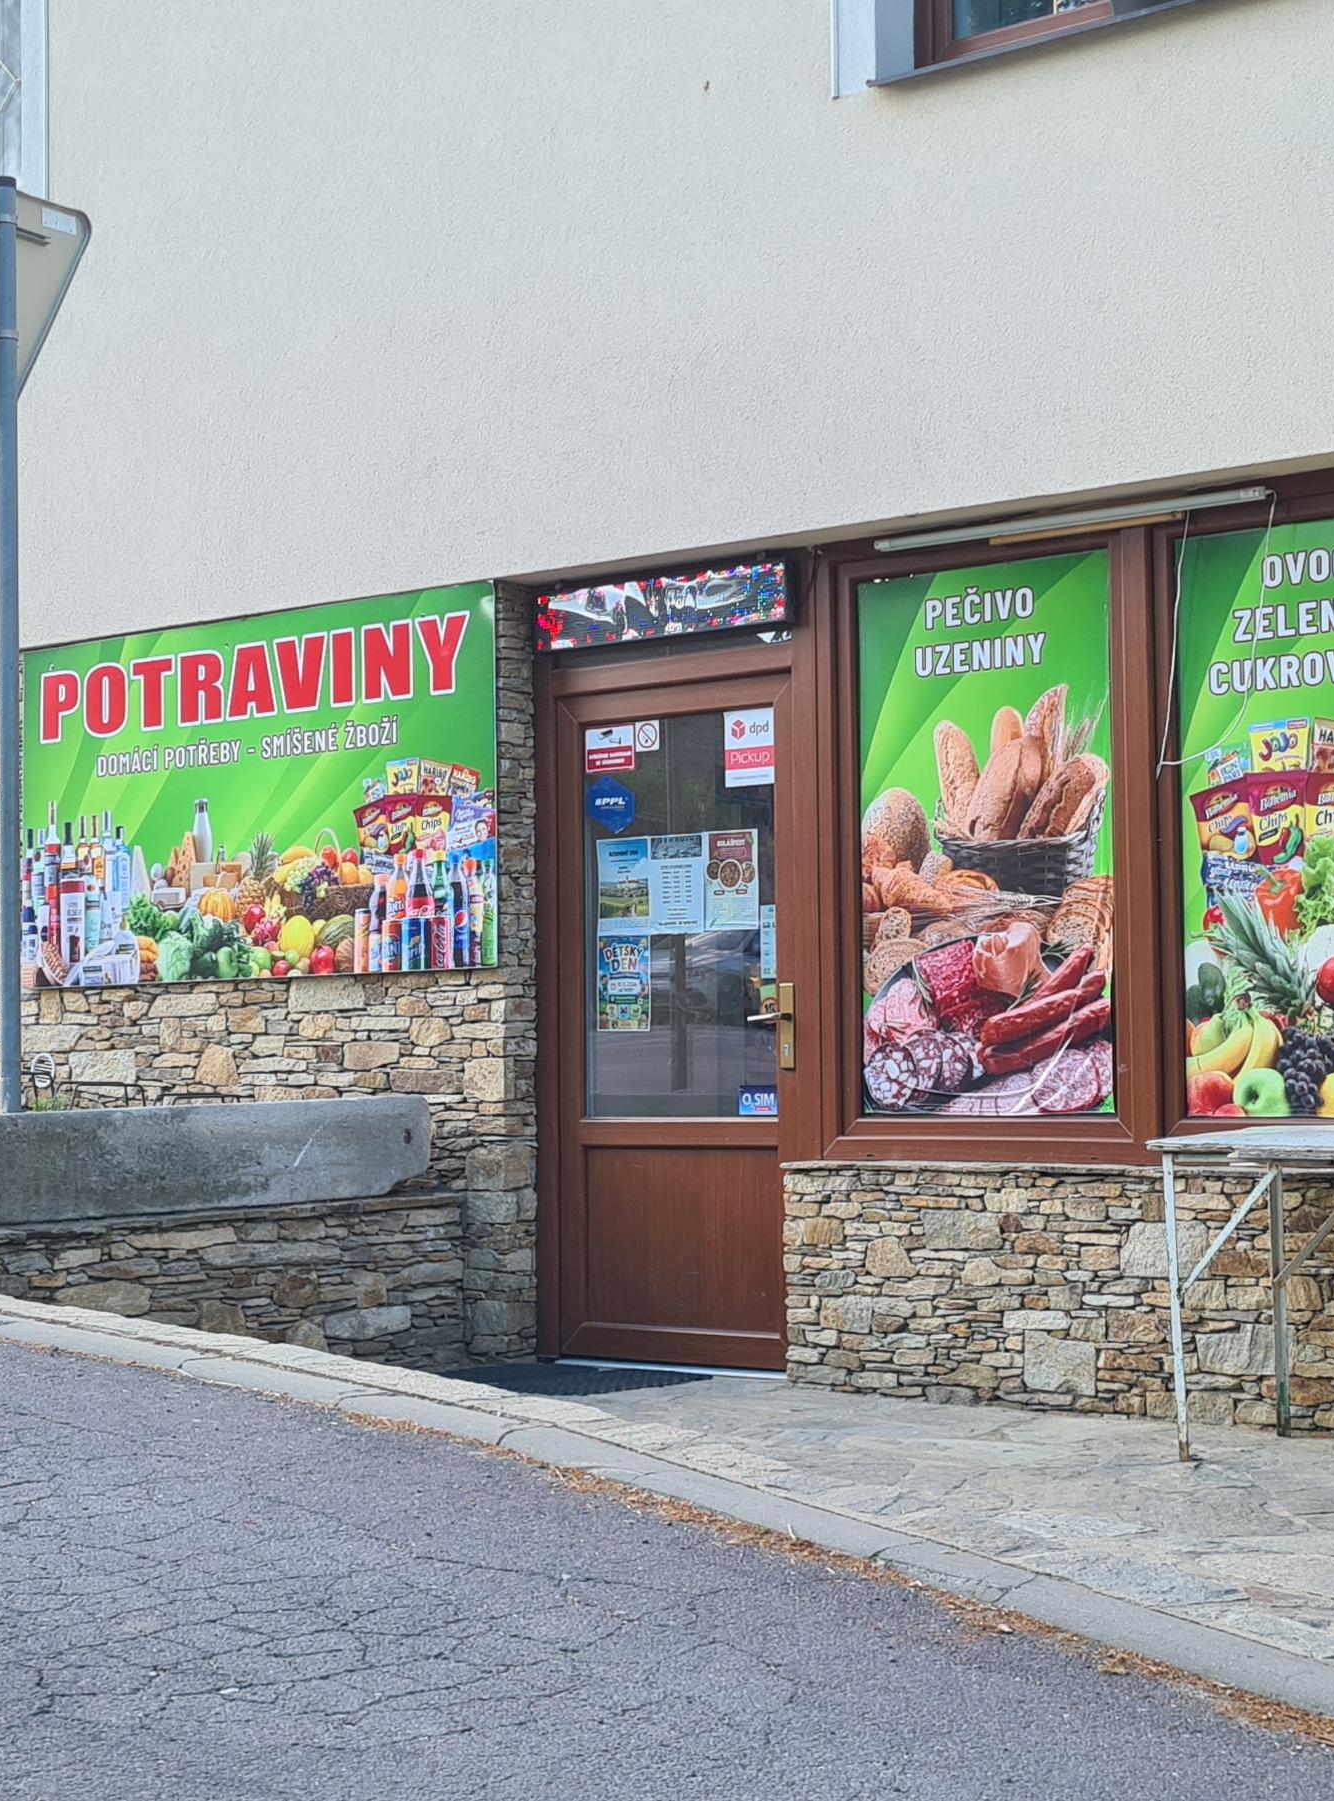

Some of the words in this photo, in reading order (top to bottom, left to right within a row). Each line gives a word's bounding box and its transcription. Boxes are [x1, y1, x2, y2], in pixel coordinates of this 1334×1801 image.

[924, 584, 1034, 631] PEČIVO
[914, 631, 1047, 678] UZENINY
[39, 611, 470, 743] POTRAVINY
[749, 720, 769, 736] dpd
[97, 745, 159, 777] DOMÁCÍ
[164, 738, 241, 770] POTŘEBY
[261, 722, 338, 760] SMÍŠENÉ
[730, 751, 770, 765] Pickup
[602, 796, 626, 805] PPL
[1259, 811, 1288, 831] Chips
[611, 958, 638, 972] DEN
[754, 1092, 775, 1107] SIM
